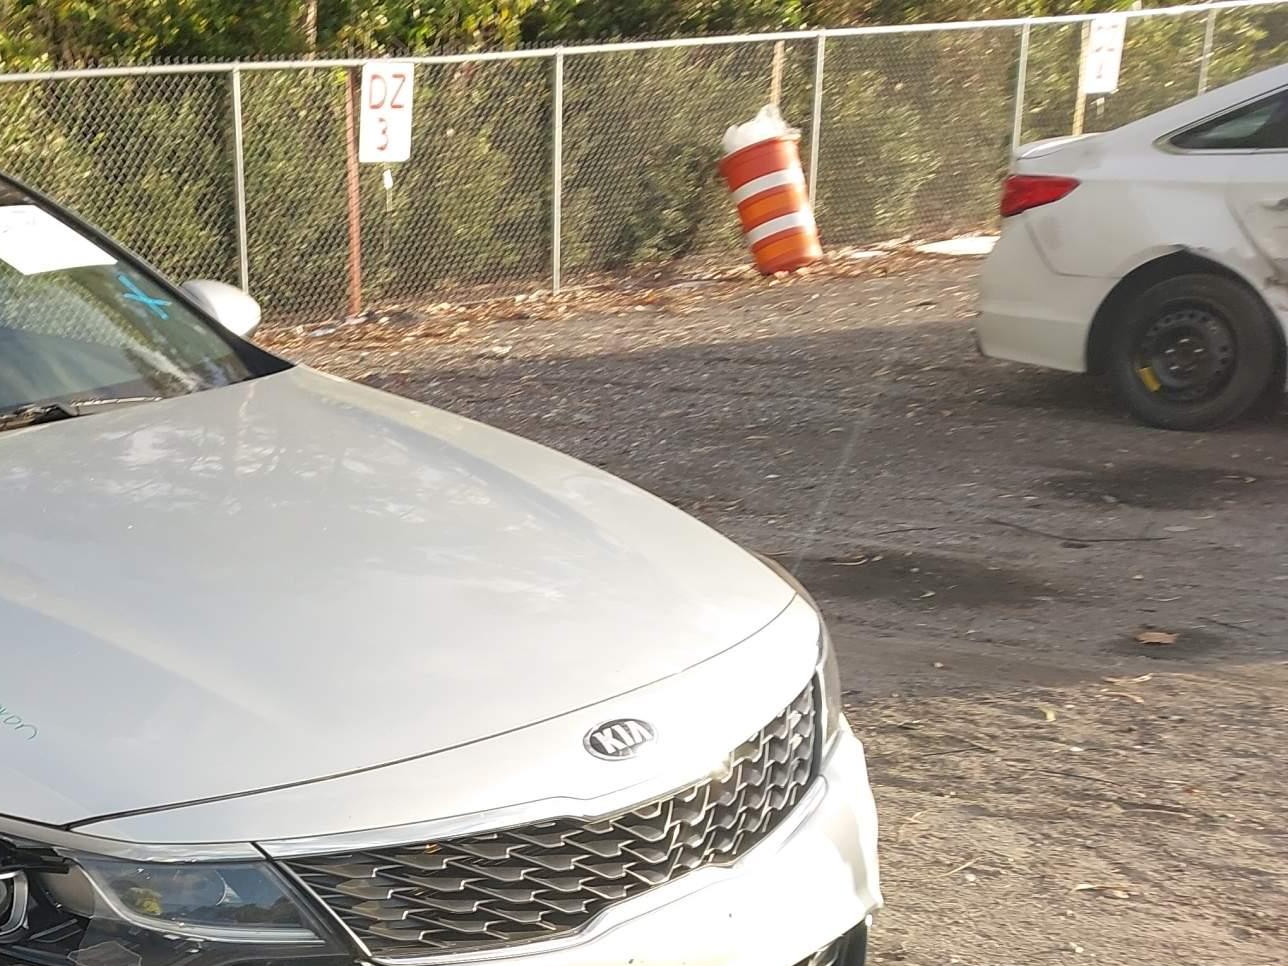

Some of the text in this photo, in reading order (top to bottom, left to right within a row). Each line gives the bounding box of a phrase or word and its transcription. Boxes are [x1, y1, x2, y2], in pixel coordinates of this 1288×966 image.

[369, 74, 406, 110] DZ
[376, 117, 389, 151] 3
[591, 720, 654, 754] KIA
